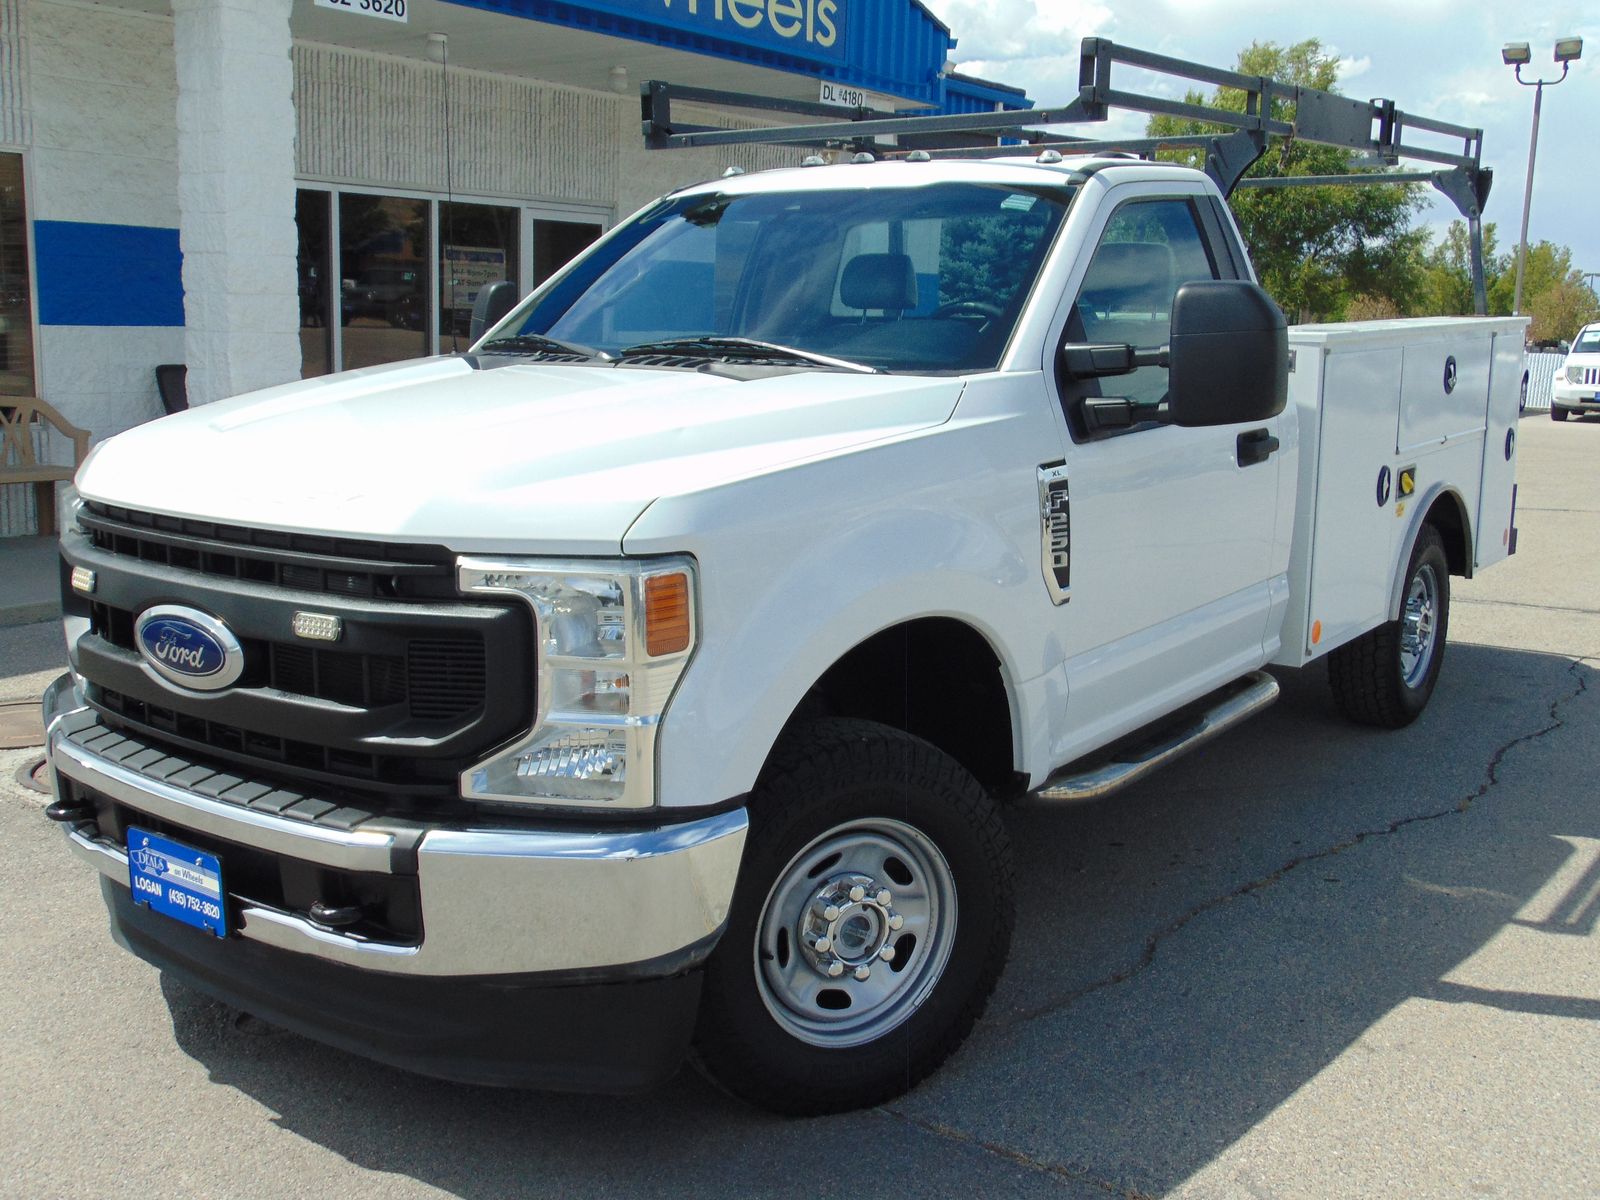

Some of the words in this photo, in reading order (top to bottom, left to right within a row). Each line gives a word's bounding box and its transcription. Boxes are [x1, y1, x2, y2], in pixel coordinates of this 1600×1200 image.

[662, 0, 837, 47] eels
[823, 84, 836, 102] DL
[155, 626, 206, 668] Ford
[138, 851, 165, 871] DEALS
[182, 868, 204, 885] Wheels
[135, 875, 162, 896] LOGAN
[168, 888, 186, 909] (435)
[187, 895, 220, 919] 752-3620
